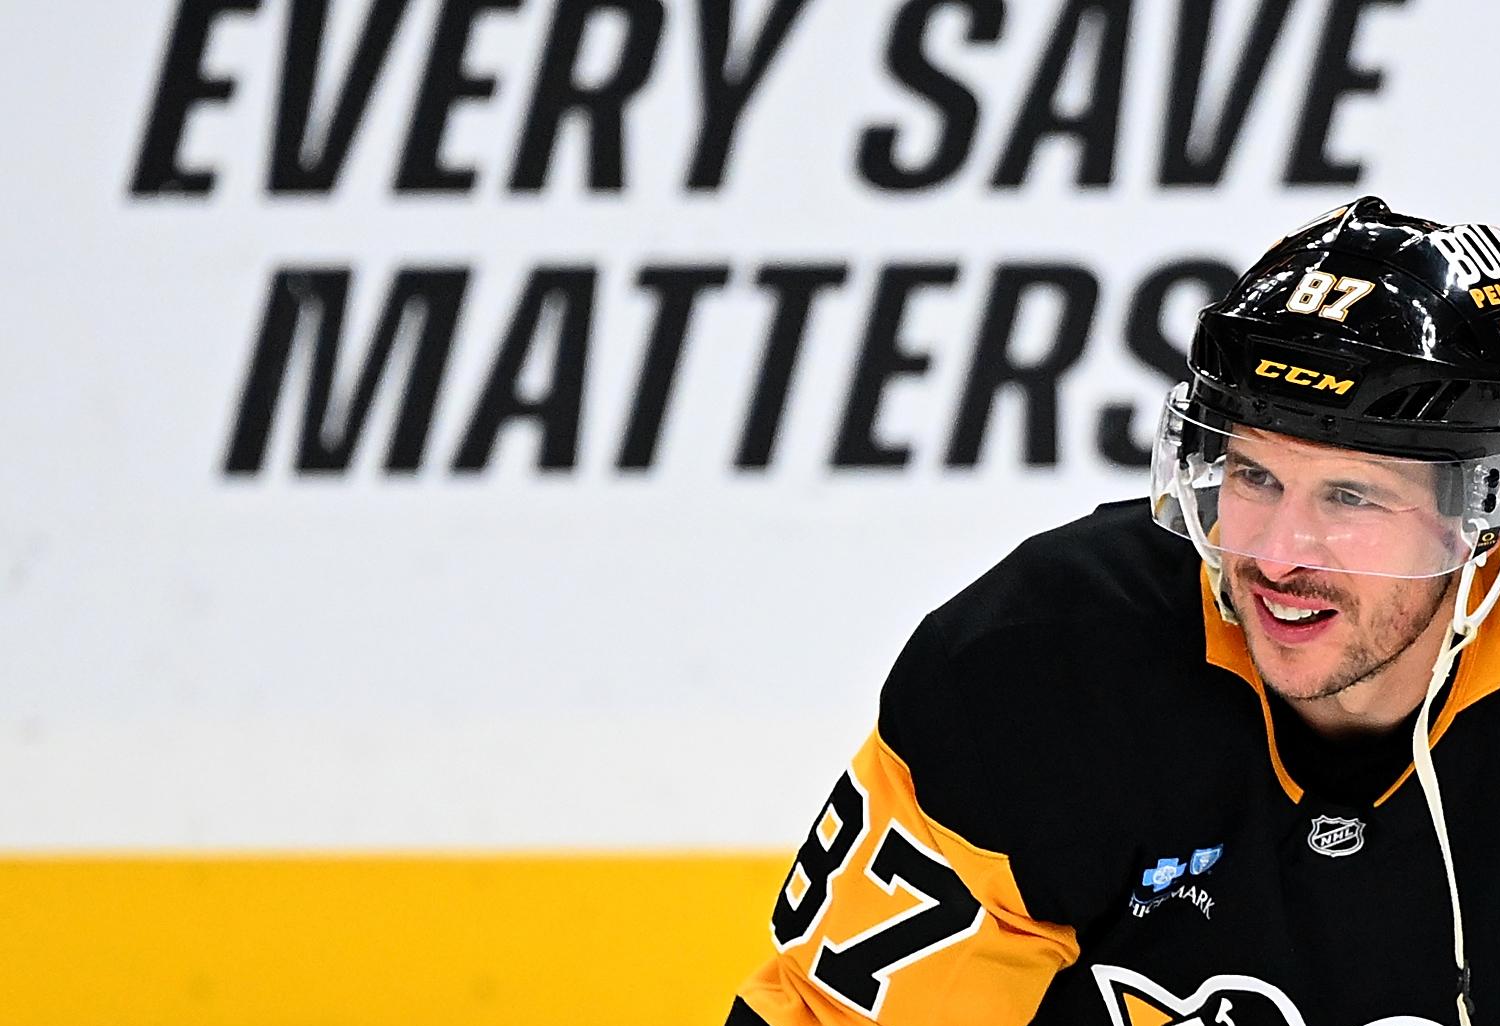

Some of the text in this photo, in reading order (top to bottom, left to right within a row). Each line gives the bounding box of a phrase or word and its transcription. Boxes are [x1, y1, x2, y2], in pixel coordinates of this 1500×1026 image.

[128, 0, 1406, 197] EVERY SAVE
[1286, 270, 1376, 323] 87
[220, 260, 1240, 478] MATTERS
[1254, 358, 1356, 396] CCM
[769, 767, 987, 1021] 87
[1320, 827, 1355, 847] NHL
